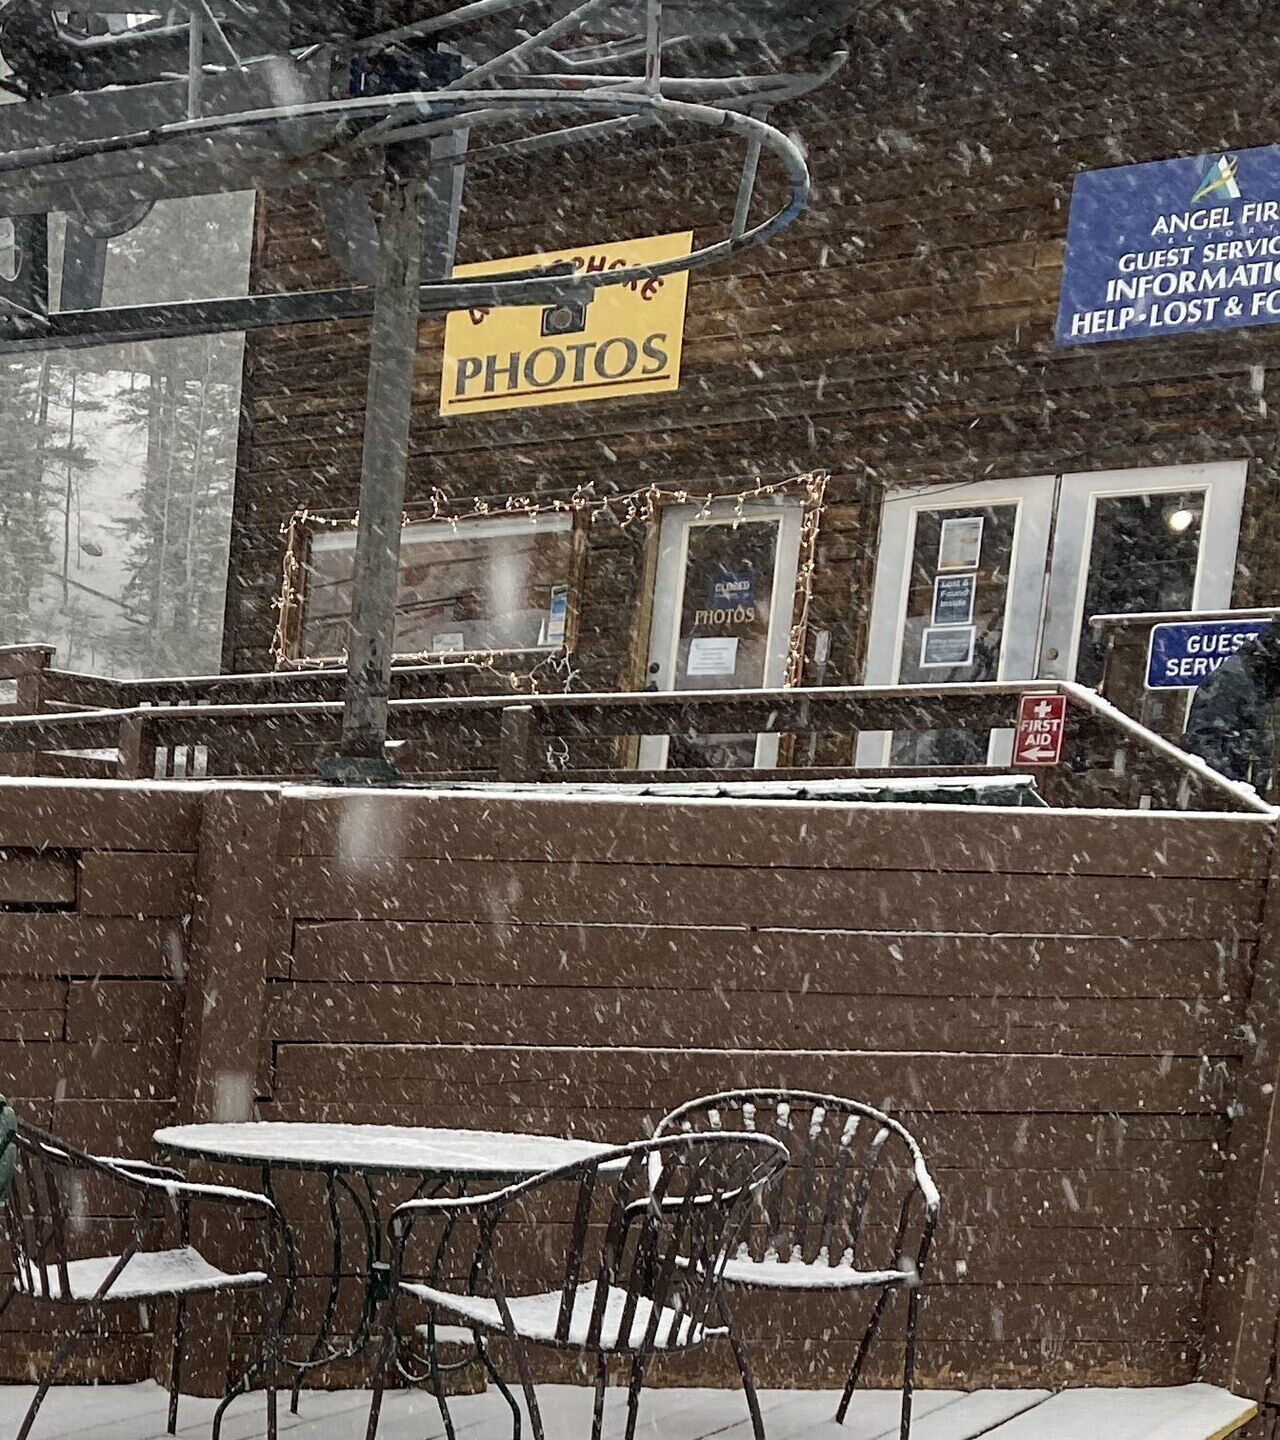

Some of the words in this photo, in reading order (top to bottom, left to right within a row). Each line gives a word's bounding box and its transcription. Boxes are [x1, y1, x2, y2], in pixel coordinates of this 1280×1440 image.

[1151, 207, 1234, 236] ANGEL
[1118, 246, 1194, 273] GUEST
[1149, 297, 1220, 327] LOST
[1224, 296, 1243, 317] &
[455, 332, 669, 397] PHOTOS
[694, 606, 755, 626] PHOTOS
[1165, 656, 1228, 677] SERV
[1021, 718, 1061, 733] FIRST
[1024, 733, 1052, 746] AID
